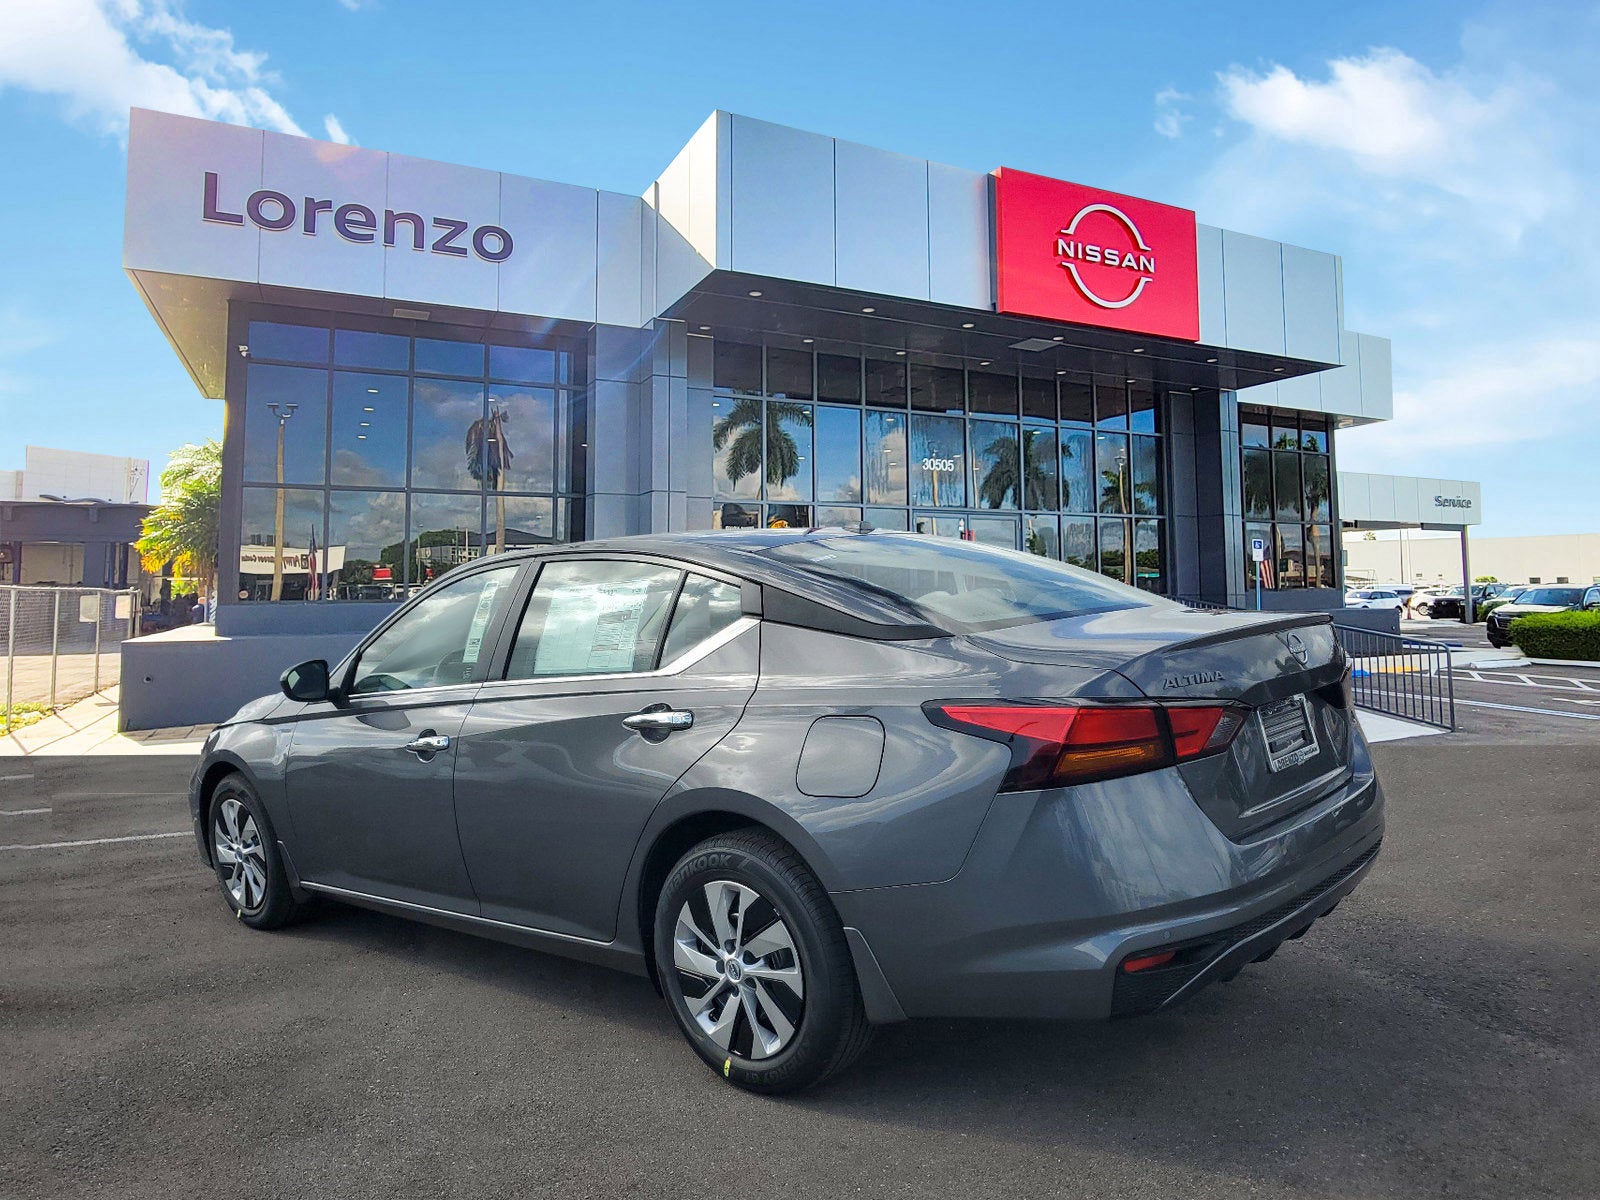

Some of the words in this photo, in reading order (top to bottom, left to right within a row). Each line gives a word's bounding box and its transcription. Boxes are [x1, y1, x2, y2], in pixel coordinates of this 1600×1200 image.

[202, 170, 515, 262] Lorenzo
[1057, 238, 1155, 273] NISSAN
[922, 457, 955, 472] 30505
[1433, 495, 1473, 509] Service
[1162, 670, 1226, 691] ALTIMA
